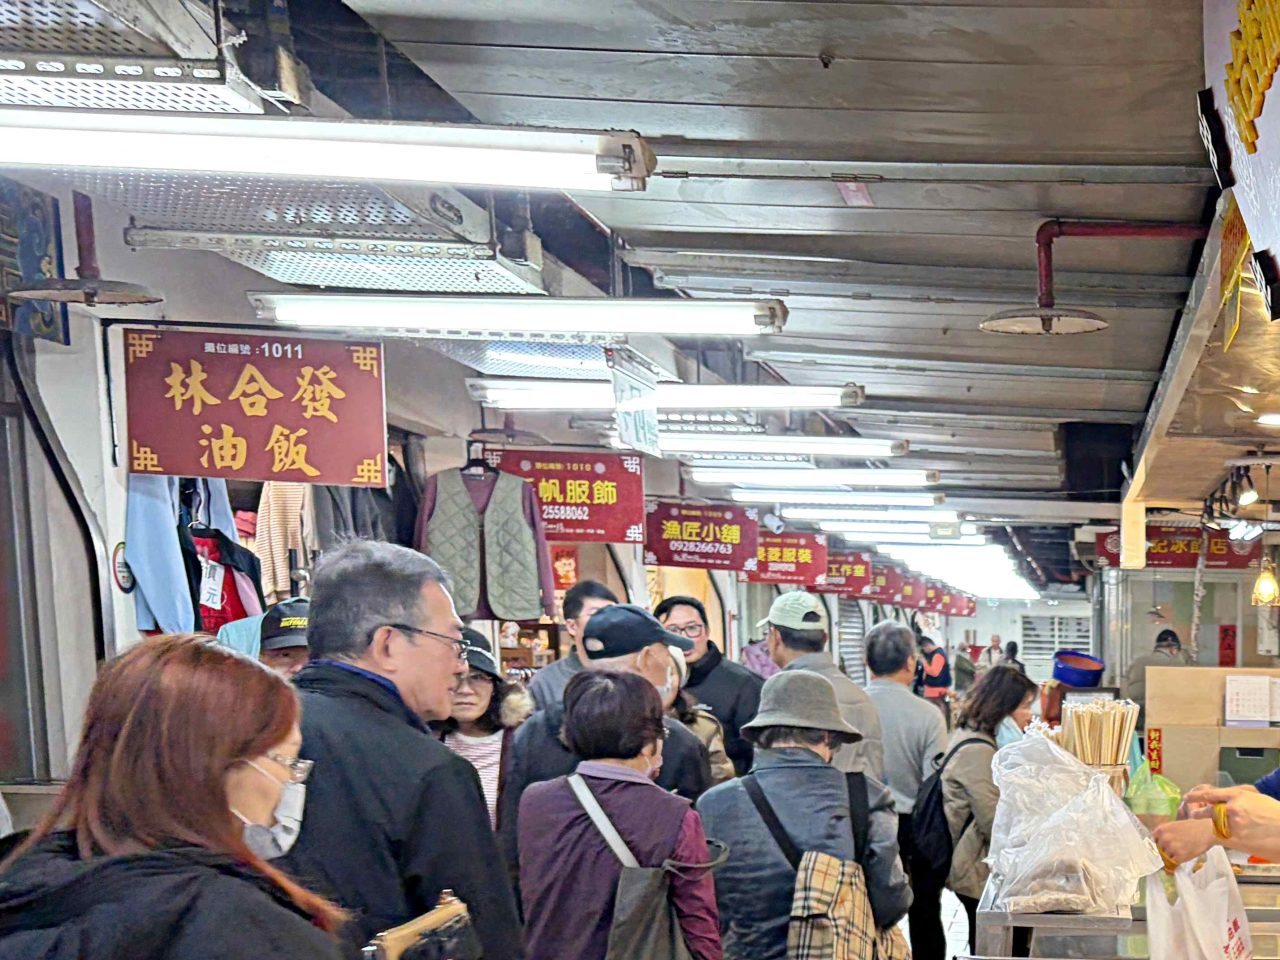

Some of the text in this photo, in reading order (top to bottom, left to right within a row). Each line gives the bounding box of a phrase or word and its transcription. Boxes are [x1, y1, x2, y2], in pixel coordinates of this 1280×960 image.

[164, 359, 346, 423] 林合發
[198, 423, 320, 477] 油飯
[527, 477, 618, 505] 帆服飾
